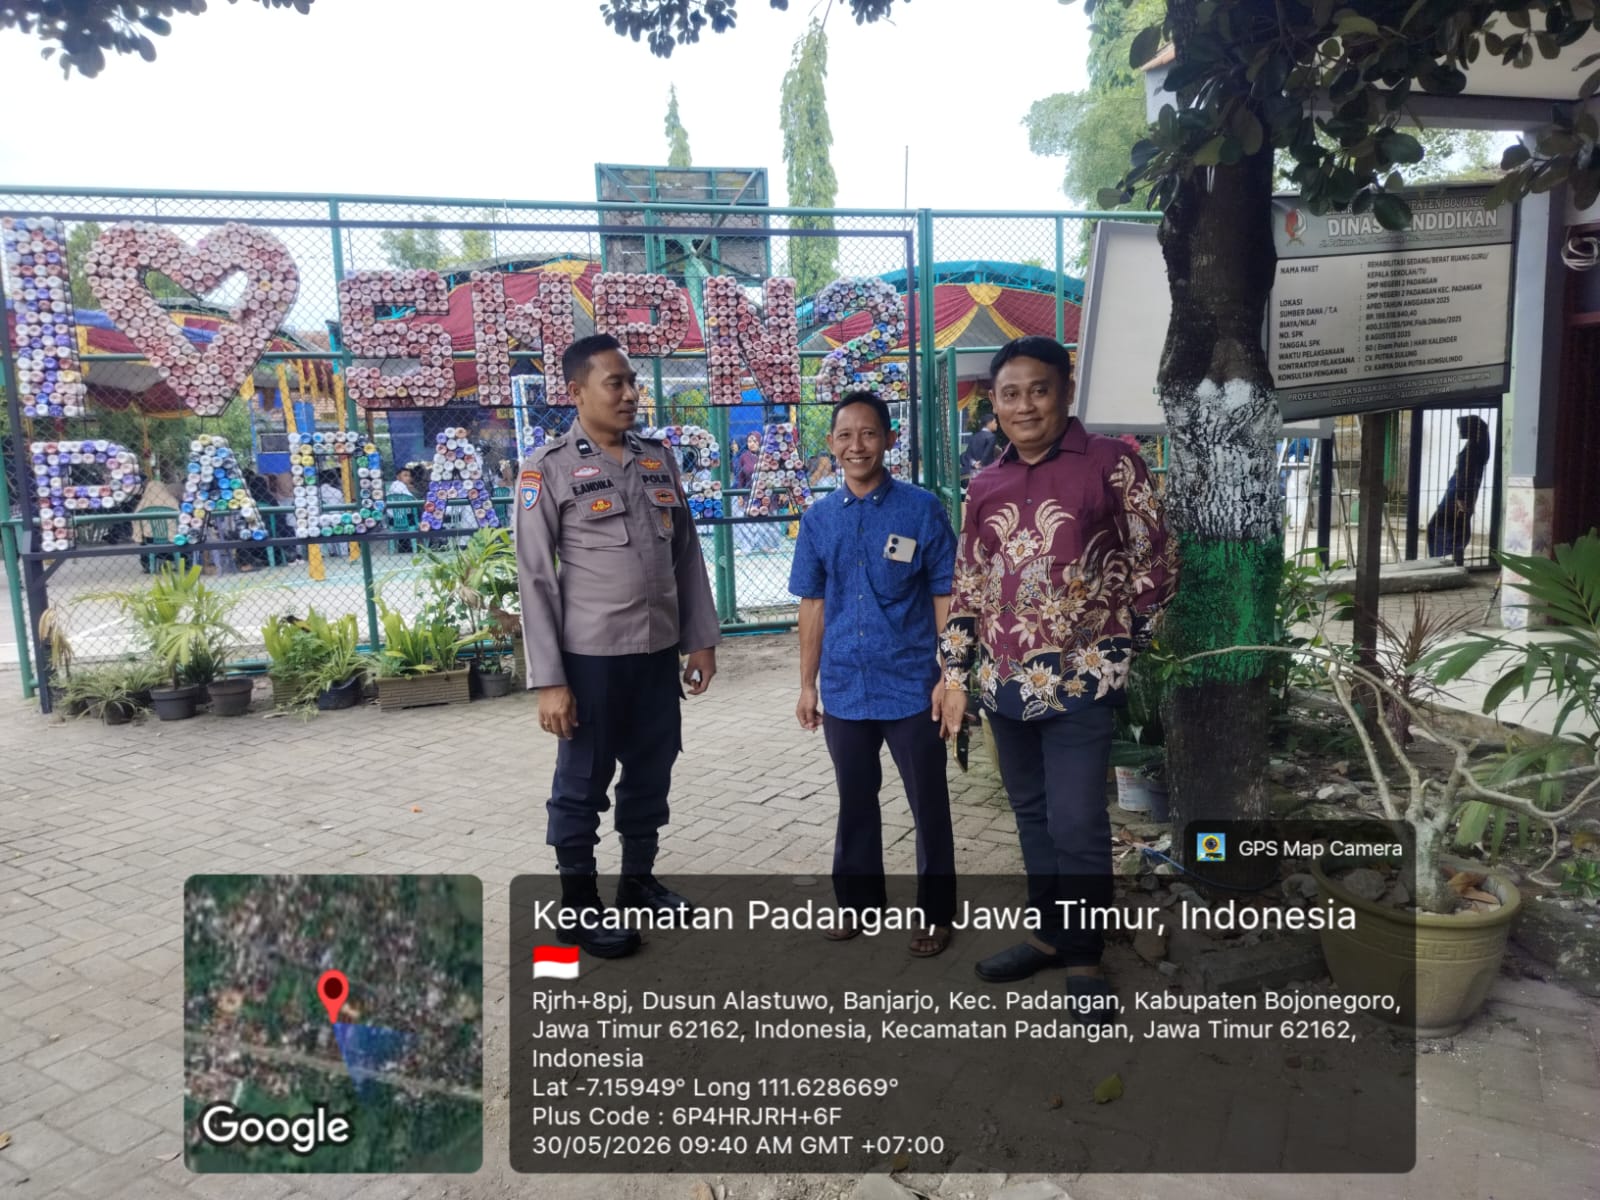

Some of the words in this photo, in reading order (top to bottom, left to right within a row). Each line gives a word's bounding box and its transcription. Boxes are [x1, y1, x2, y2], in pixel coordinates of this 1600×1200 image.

[1366, 270, 1389, 278] KEPALA
[1405, 277, 1437, 285] PADANGAN
[1279, 298, 1303, 306] LOKASI
[1405, 287, 1437, 296] PADANGAN
[1451, 283, 1482, 292] PADANGAN
[3, 217, 86, 417] I
[1279, 308, 1305, 317] SUMBER
[1305, 307, 1323, 315] DANA
[1403, 297, 1435, 306] ANGGARAN
[1278, 340, 1307, 349] TANGGAL
[1370, 331, 1396, 340] AGUSTUS
[1278, 351, 1301, 359] WAKTU
[1302, 347, 1344, 357] PELAKSANAAN
[1427, 336, 1458, 345] KALENDER
[1277, 360, 1320, 370] KONTRAKTOR
[1319, 357, 1354, 366] PELAKSANA
[1374, 352, 1393, 360] PUTRA
[1277, 371, 1312, 380] KONSULTAN
[1313, 368, 1347, 376] PENGAWAS
[1373, 362, 1394, 370] KARYA
[1407, 359, 1426, 367] PUTRA
